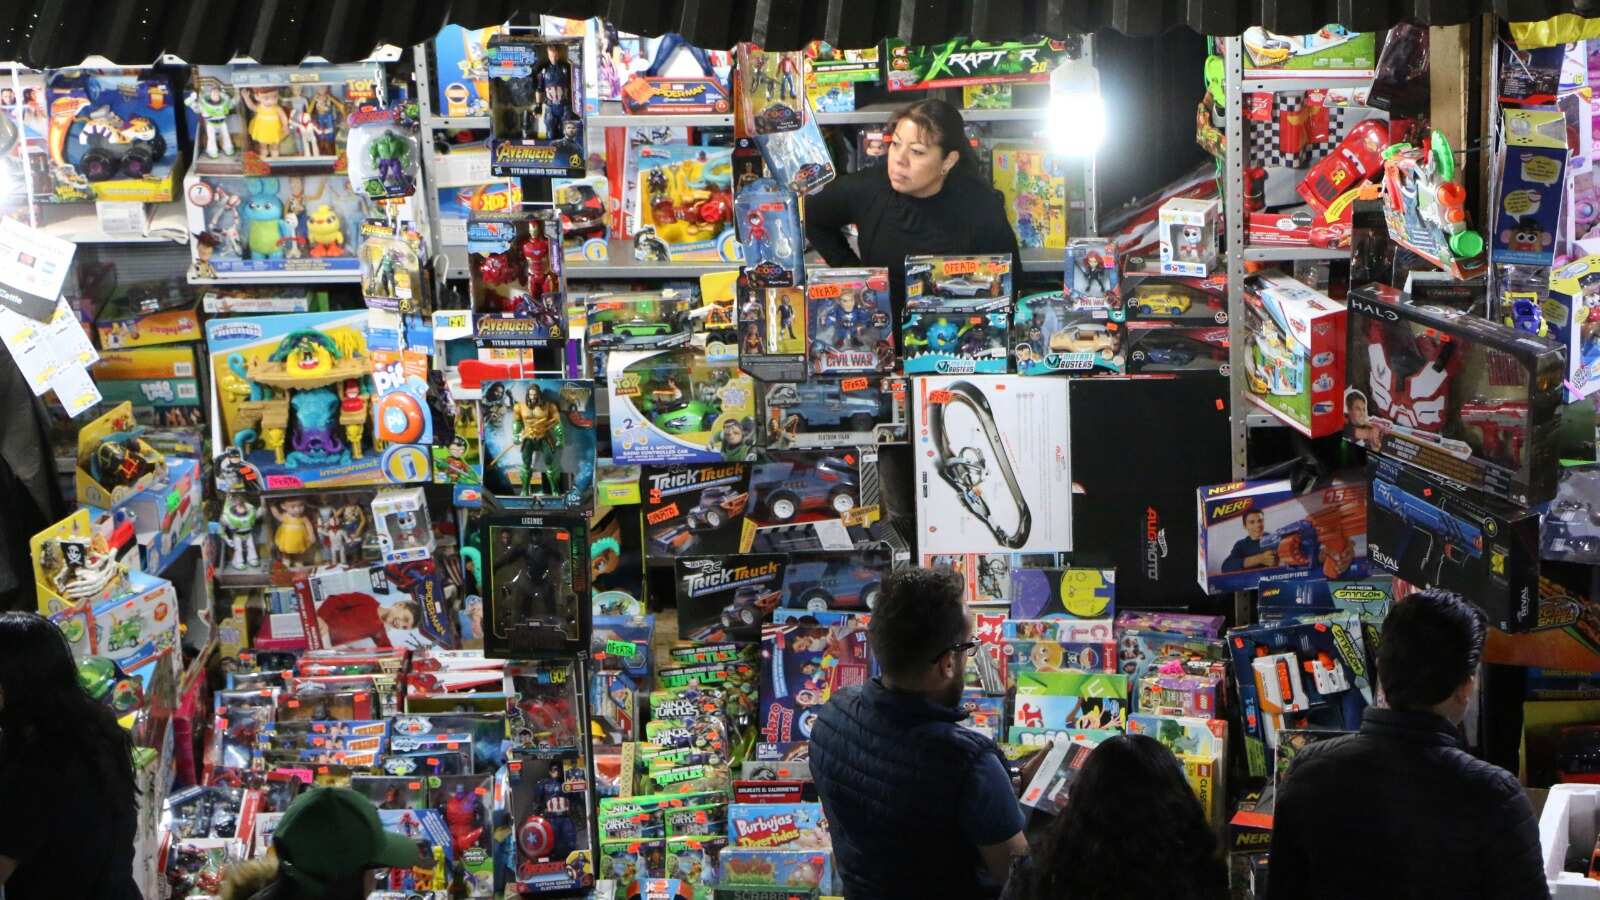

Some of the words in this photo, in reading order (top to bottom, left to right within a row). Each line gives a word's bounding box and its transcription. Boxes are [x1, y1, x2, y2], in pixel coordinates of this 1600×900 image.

[496, 145, 557, 162] AVENGERS
[756, 266, 781, 274] COCO
[944, 261, 976, 274] OFERTA
[1352, 299, 1399, 321] HALO
[478, 317, 534, 335] AVENGERS
[827, 353, 849, 367] CIVIL
[852, 353, 873, 367] WAR
[1060, 360, 1092, 369] BUSTERS
[614, 373, 641, 388] TOY
[624, 418, 634, 430] 2
[1208, 482, 1249, 496] NERF
[1212, 498, 1252, 518] NERF
[1372, 551, 1399, 569] RIVAL
[423, 578, 447, 637] SPIDER-MAN
[1521, 586, 1530, 617] RIVAL
[656, 706, 700, 719] TURTLES
[660, 700, 692, 711] NINJA
[656, 728, 692, 738] NINJA
[656, 768, 704, 787] TURTLES
[736, 814, 793, 836] Burbujas
